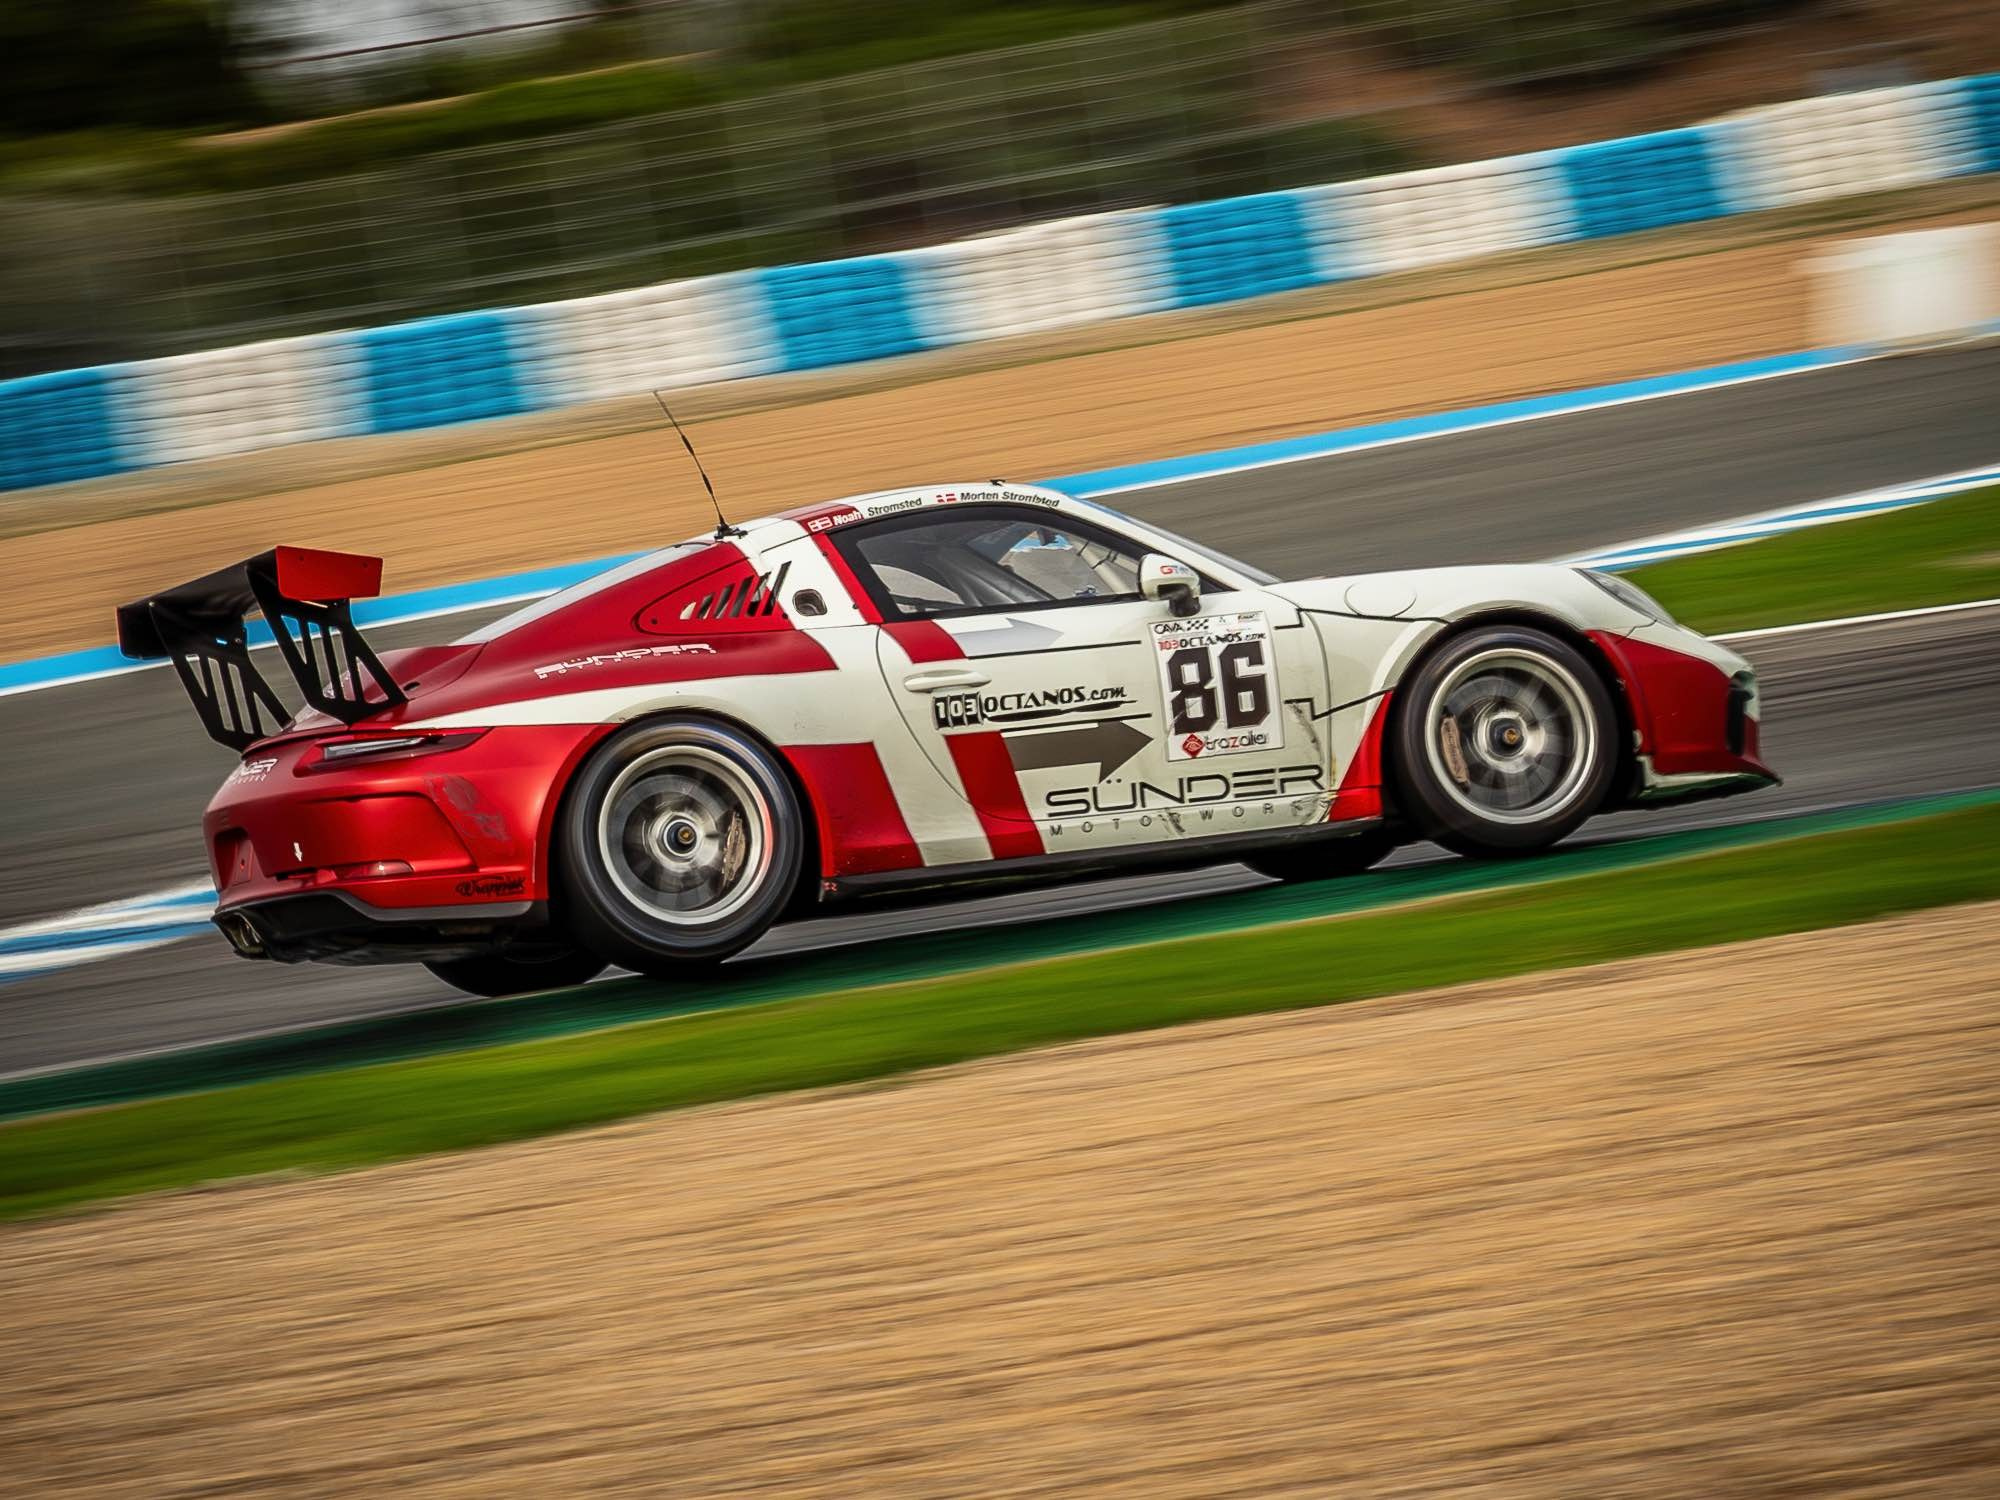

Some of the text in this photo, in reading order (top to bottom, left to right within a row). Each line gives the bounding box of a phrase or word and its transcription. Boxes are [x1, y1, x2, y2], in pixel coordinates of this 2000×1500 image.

[960, 491, 999, 501] Morten
[833, 497, 922, 526] Noah Stromsted
[1154, 622, 1184, 635] CAVA
[1168, 641, 1270, 736] 86
[1046, 764, 1325, 817] SÜNDER
